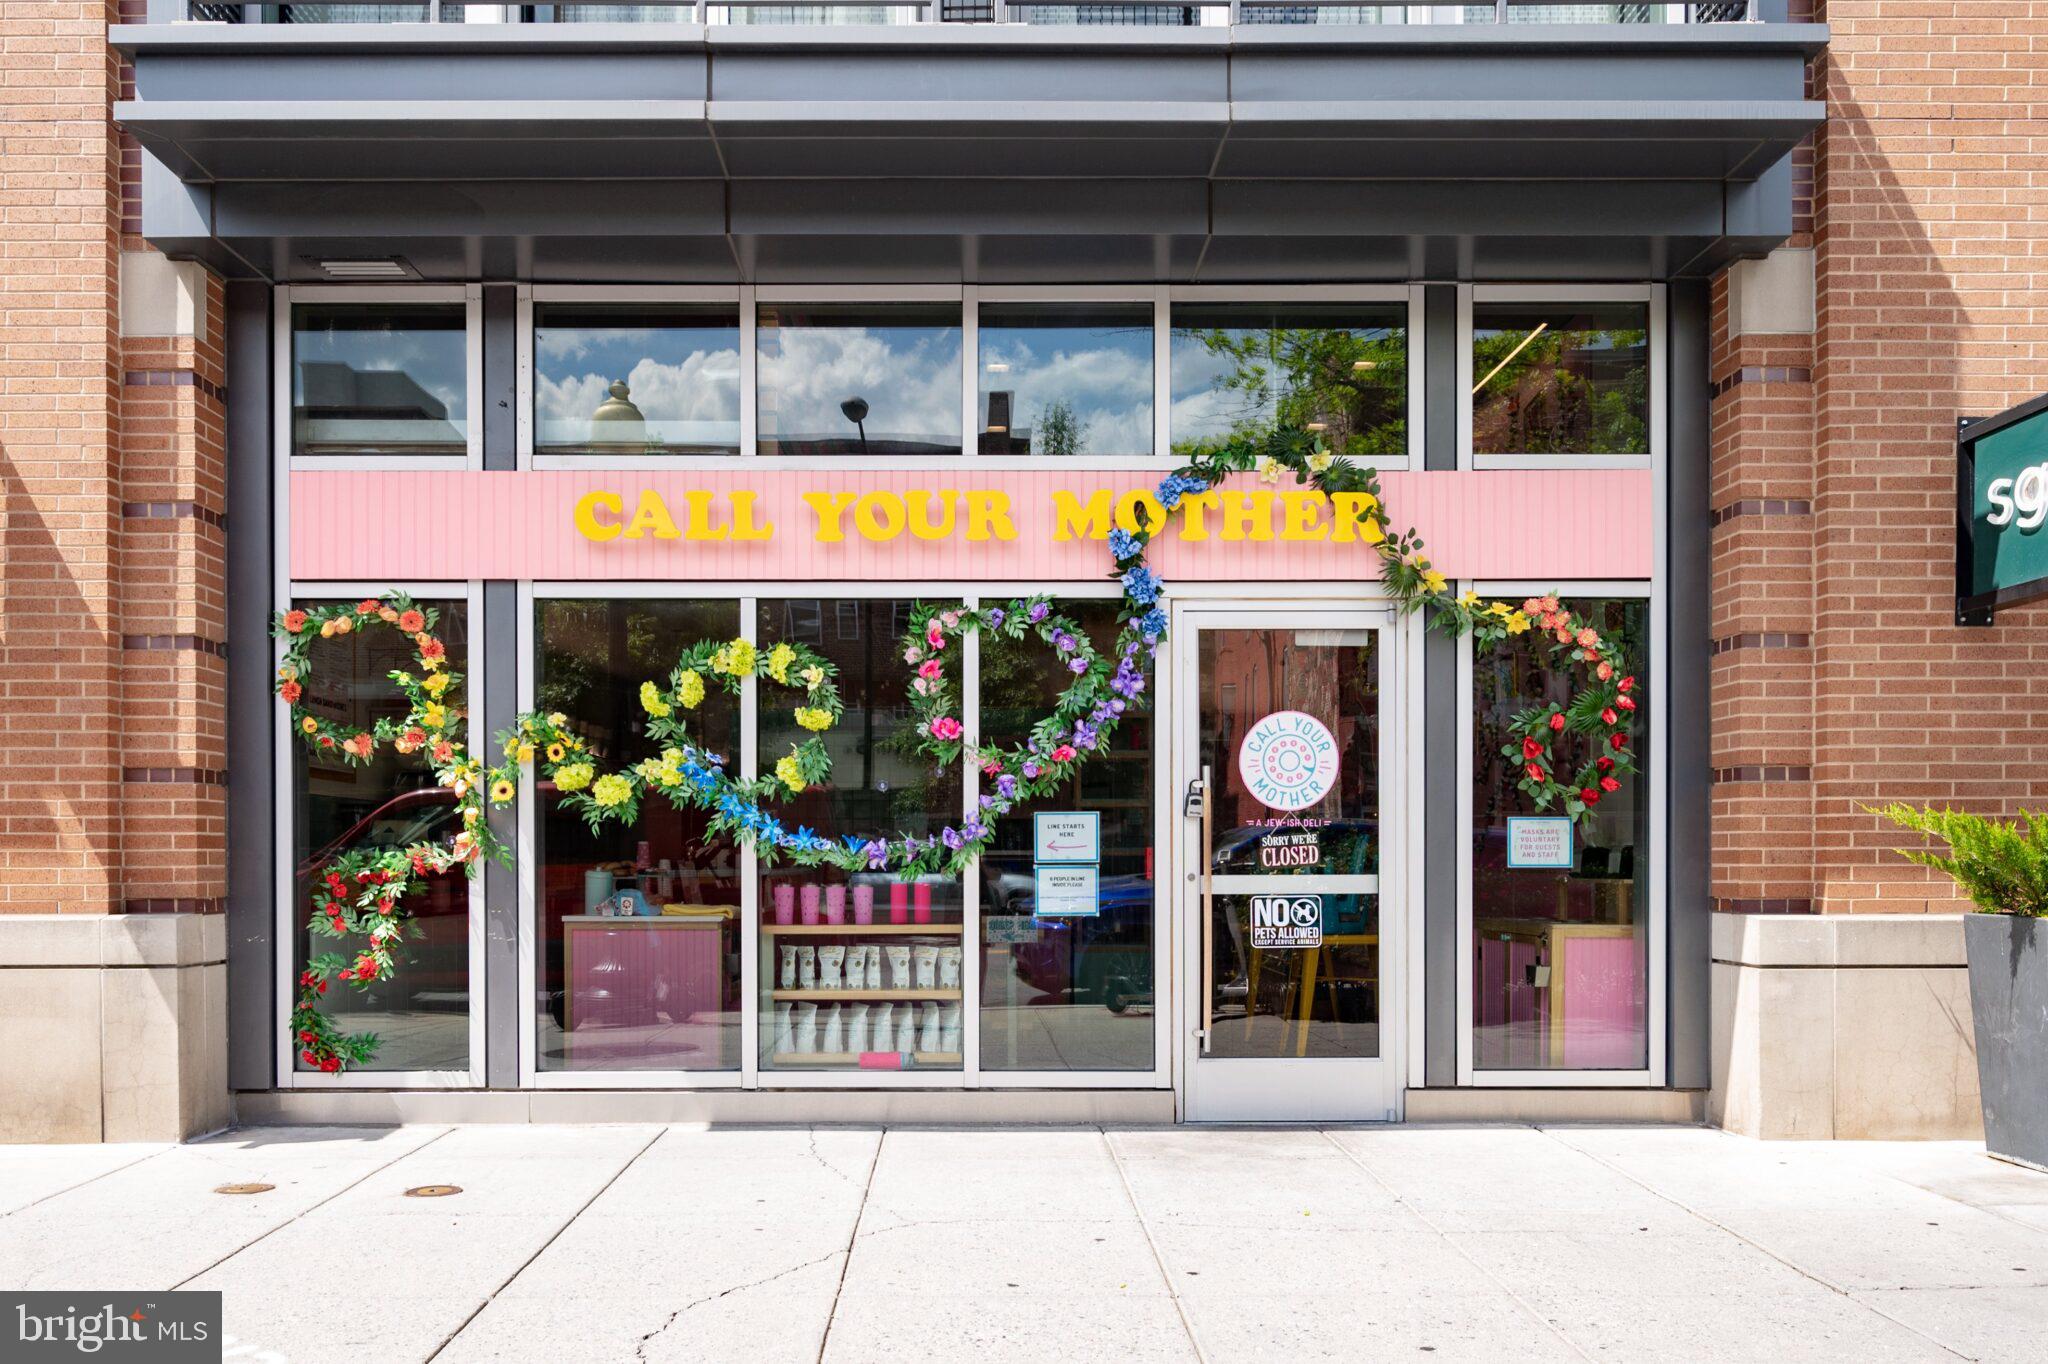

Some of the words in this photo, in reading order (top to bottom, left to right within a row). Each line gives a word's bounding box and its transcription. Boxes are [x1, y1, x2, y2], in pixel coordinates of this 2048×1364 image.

[574, 488, 774, 542] CALL
[802, 489, 1019, 542] YOUR
[1052, 489, 1386, 543] MOTHER
[1248, 717, 1286, 752] CALL
[1295, 717, 1331, 753] YOUR
[1253, 778, 1323, 806] MOTHER
[1255, 819, 1262, 827] A
[1264, 818, 1300, 827] JEW-ISH
[1303, 818, 1322, 827] DELI
[1262, 834, 1289, 847] SORRY
[1291, 833, 1318, 845] WE'RE
[1262, 845, 1319, 867] CLOSED
[1254, 898, 1290, 927] NO
[1255, 927, 1277, 939] PETS
[1278, 927, 1319, 939] ALLOWED
